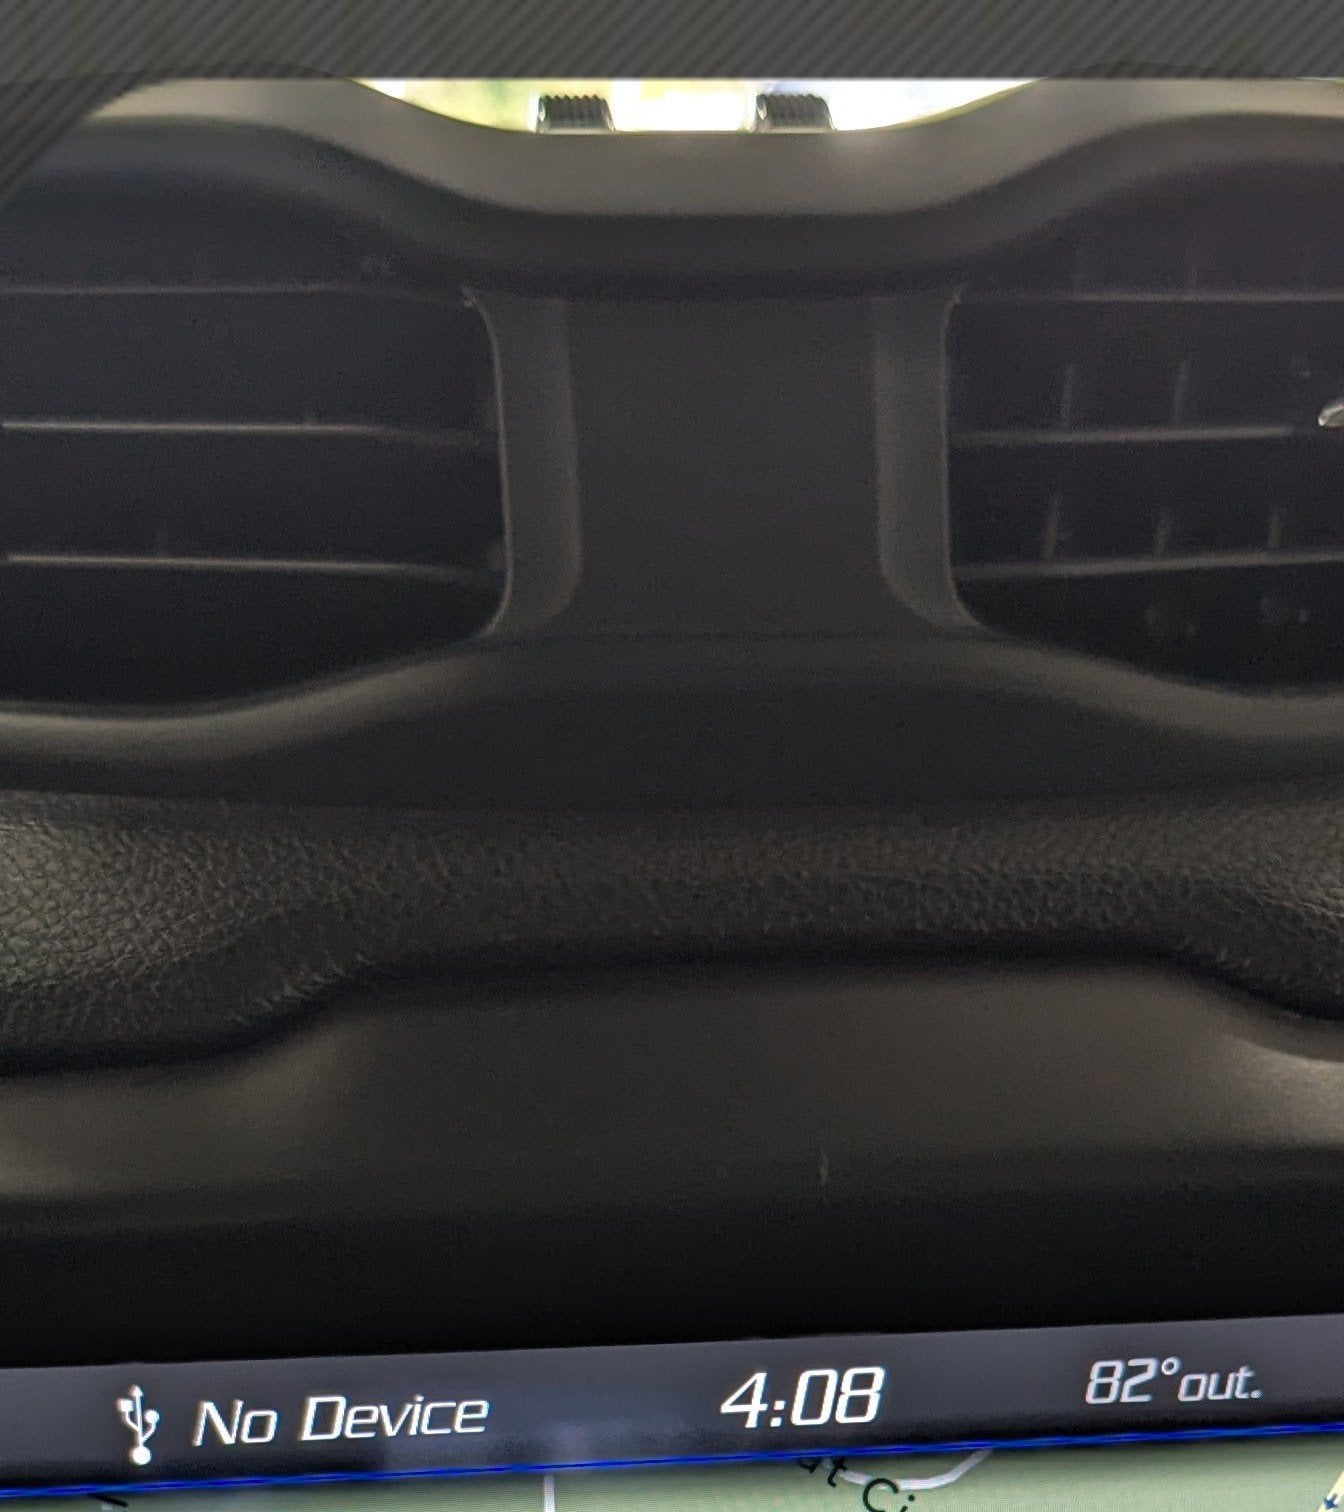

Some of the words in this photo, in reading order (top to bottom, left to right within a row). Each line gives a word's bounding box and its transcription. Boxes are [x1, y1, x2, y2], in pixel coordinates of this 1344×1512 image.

[194, 1398, 278, 1447] No
[300, 1394, 490, 1441] Device
[720, 1365, 887, 1430] 4:08
